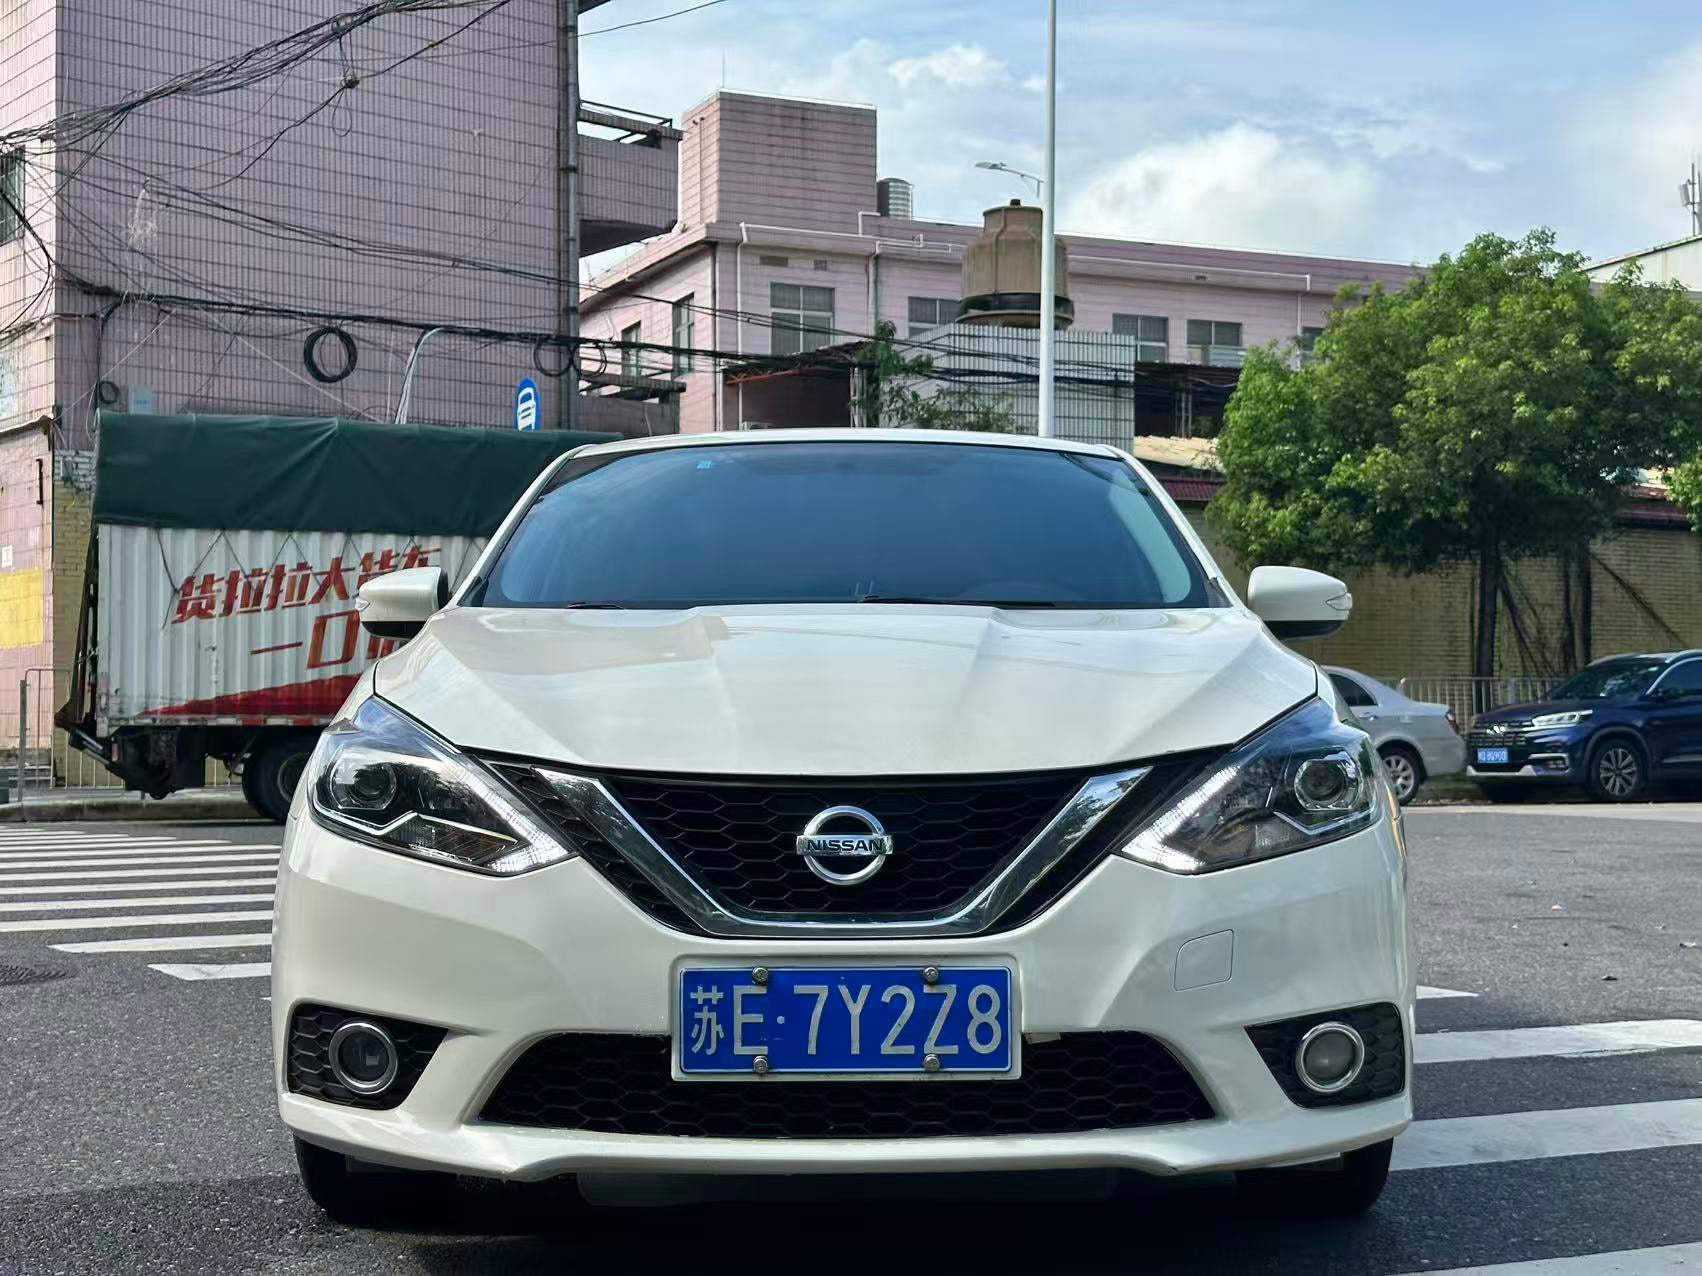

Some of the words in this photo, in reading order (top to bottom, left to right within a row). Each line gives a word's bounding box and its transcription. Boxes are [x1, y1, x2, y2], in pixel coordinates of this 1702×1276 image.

[251, 609, 394, 669] 一口
[806, 838, 883, 853] NISSAN
[690, 984, 1002, 1056] 苏E·7Y2Z8
